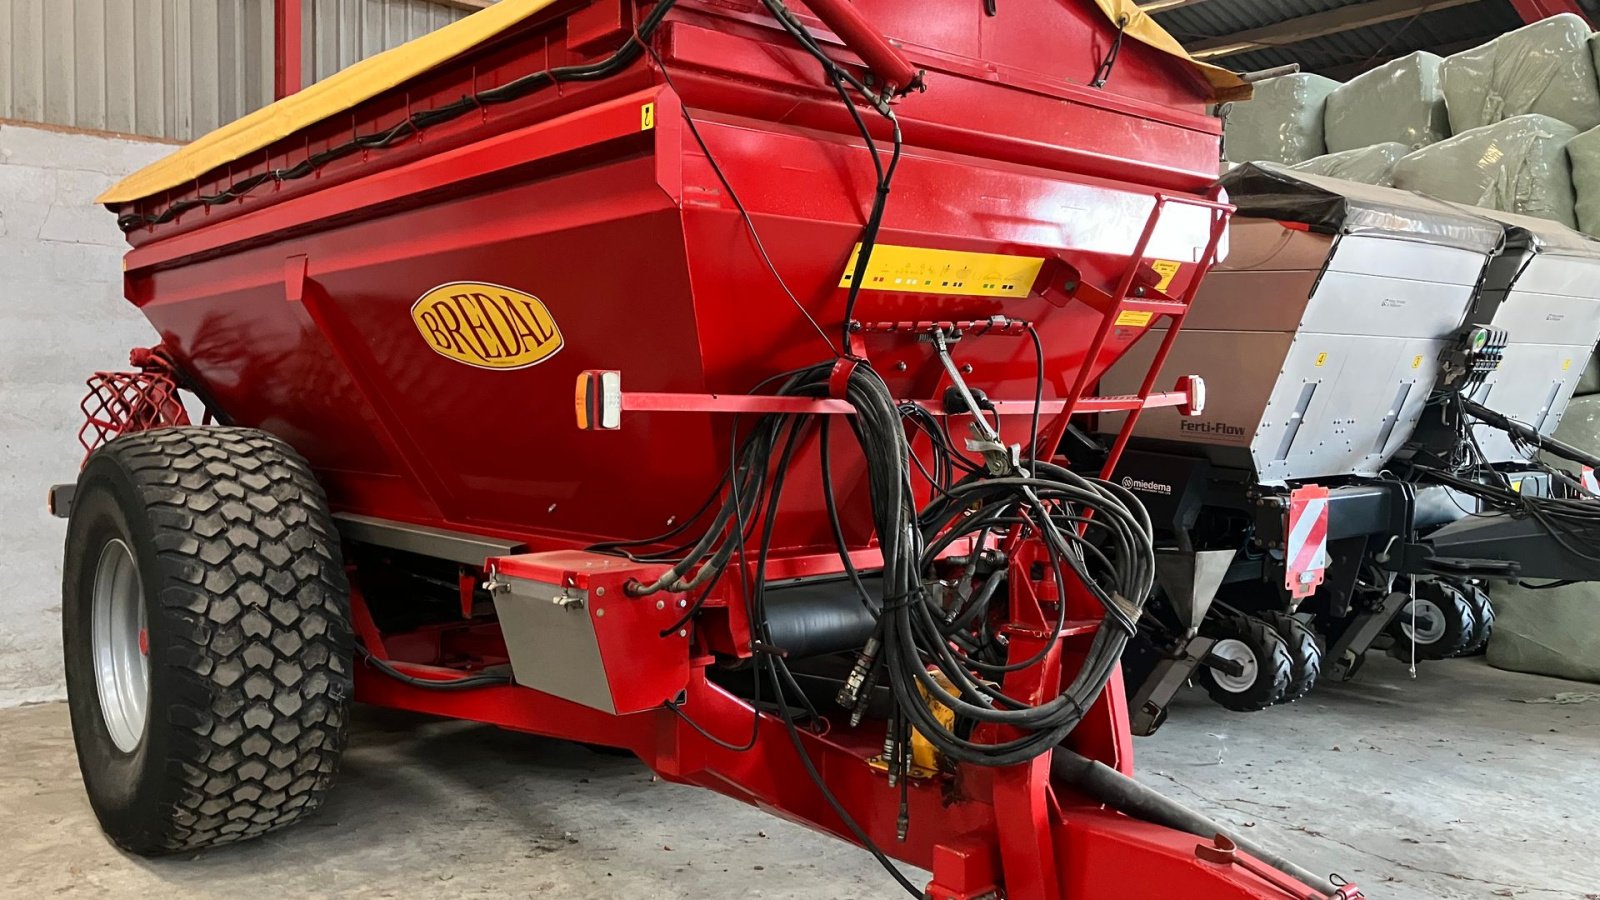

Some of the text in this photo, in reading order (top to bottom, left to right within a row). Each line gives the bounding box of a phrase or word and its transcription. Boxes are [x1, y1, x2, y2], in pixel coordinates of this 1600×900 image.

[420, 293, 554, 363] BREDAL
[1180, 420, 1246, 435] Ferti-Flow
[1133, 480, 1171, 491] miedema
